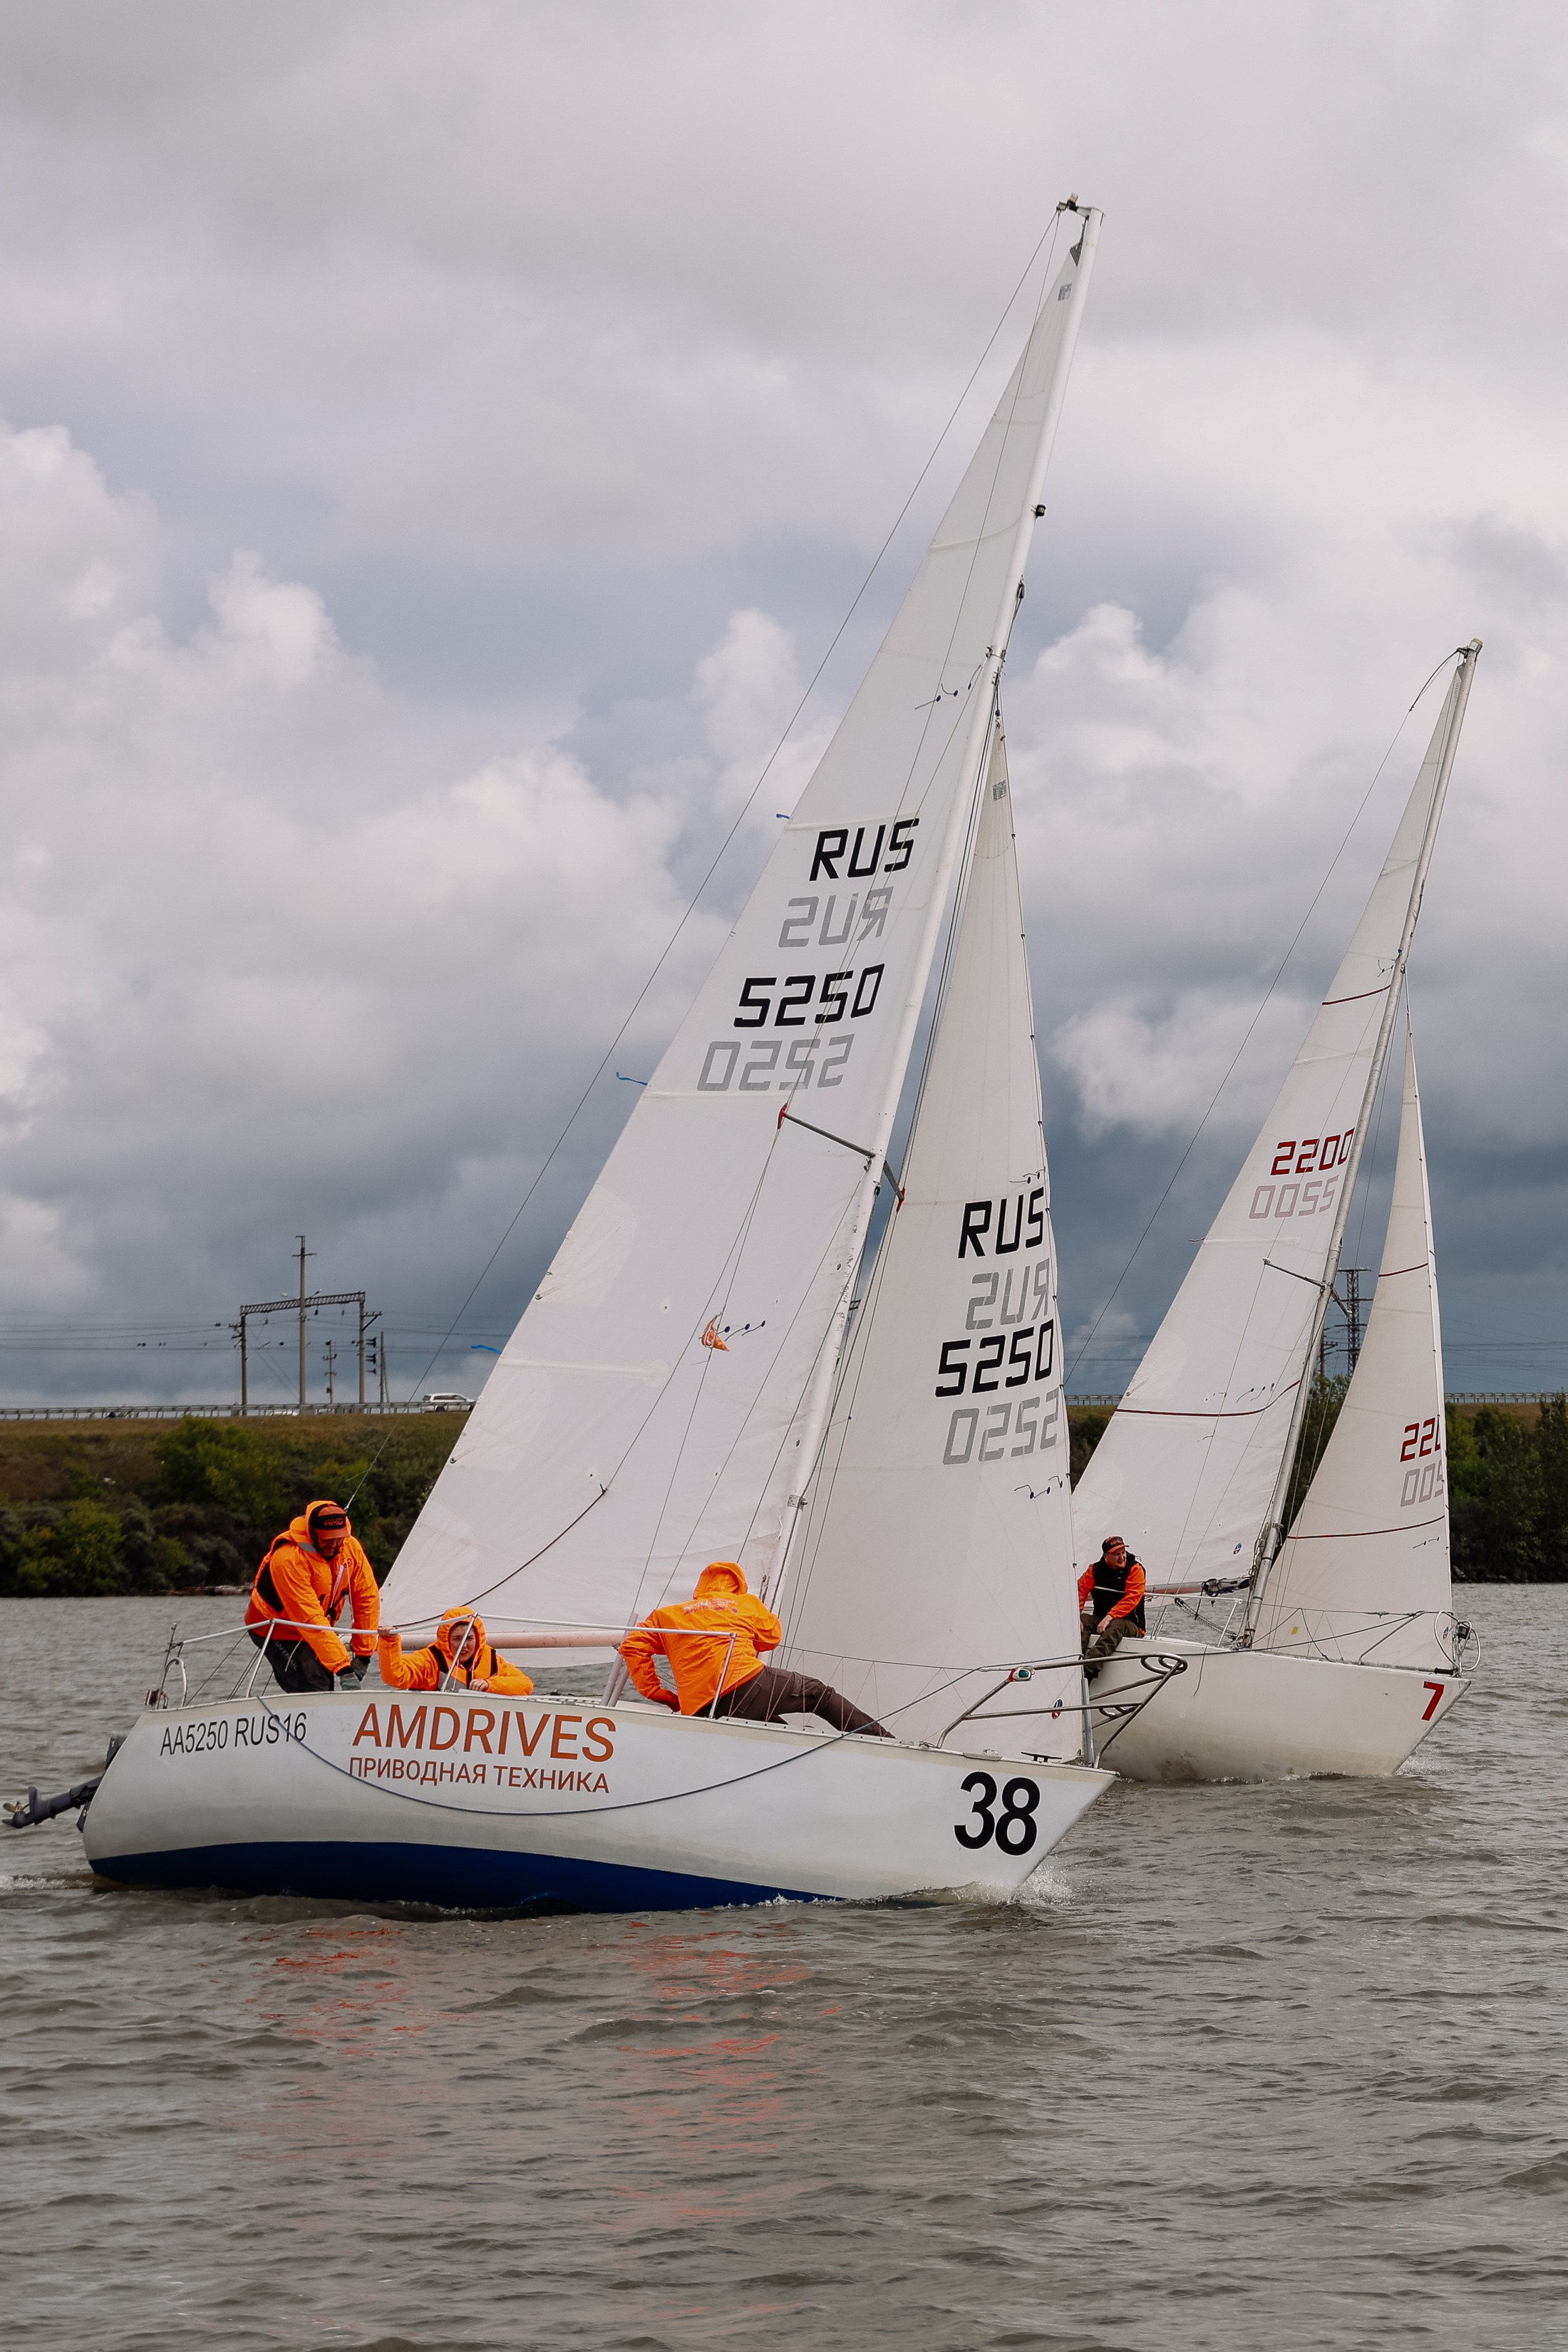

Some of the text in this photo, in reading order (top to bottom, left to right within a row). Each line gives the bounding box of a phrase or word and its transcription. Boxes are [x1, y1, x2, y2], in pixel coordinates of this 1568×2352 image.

[808, 817, 919, 882] RUS
[733, 963, 885, 1028] 5250
[1270, 1127, 1355, 1176] 2200
[958, 1186, 1044, 1259] RUS
[934, 1319, 1054, 1398] 5250
[1421, 1681, 1445, 1721] 7
[160, 1719, 229, 1756] AA5250
[352, 1703, 617, 1763] AMDRIVES
[349, 1757, 610, 1794] ПРИВОДНАЯ ТЕХНИКА
[954, 1771, 1041, 1856] 38
